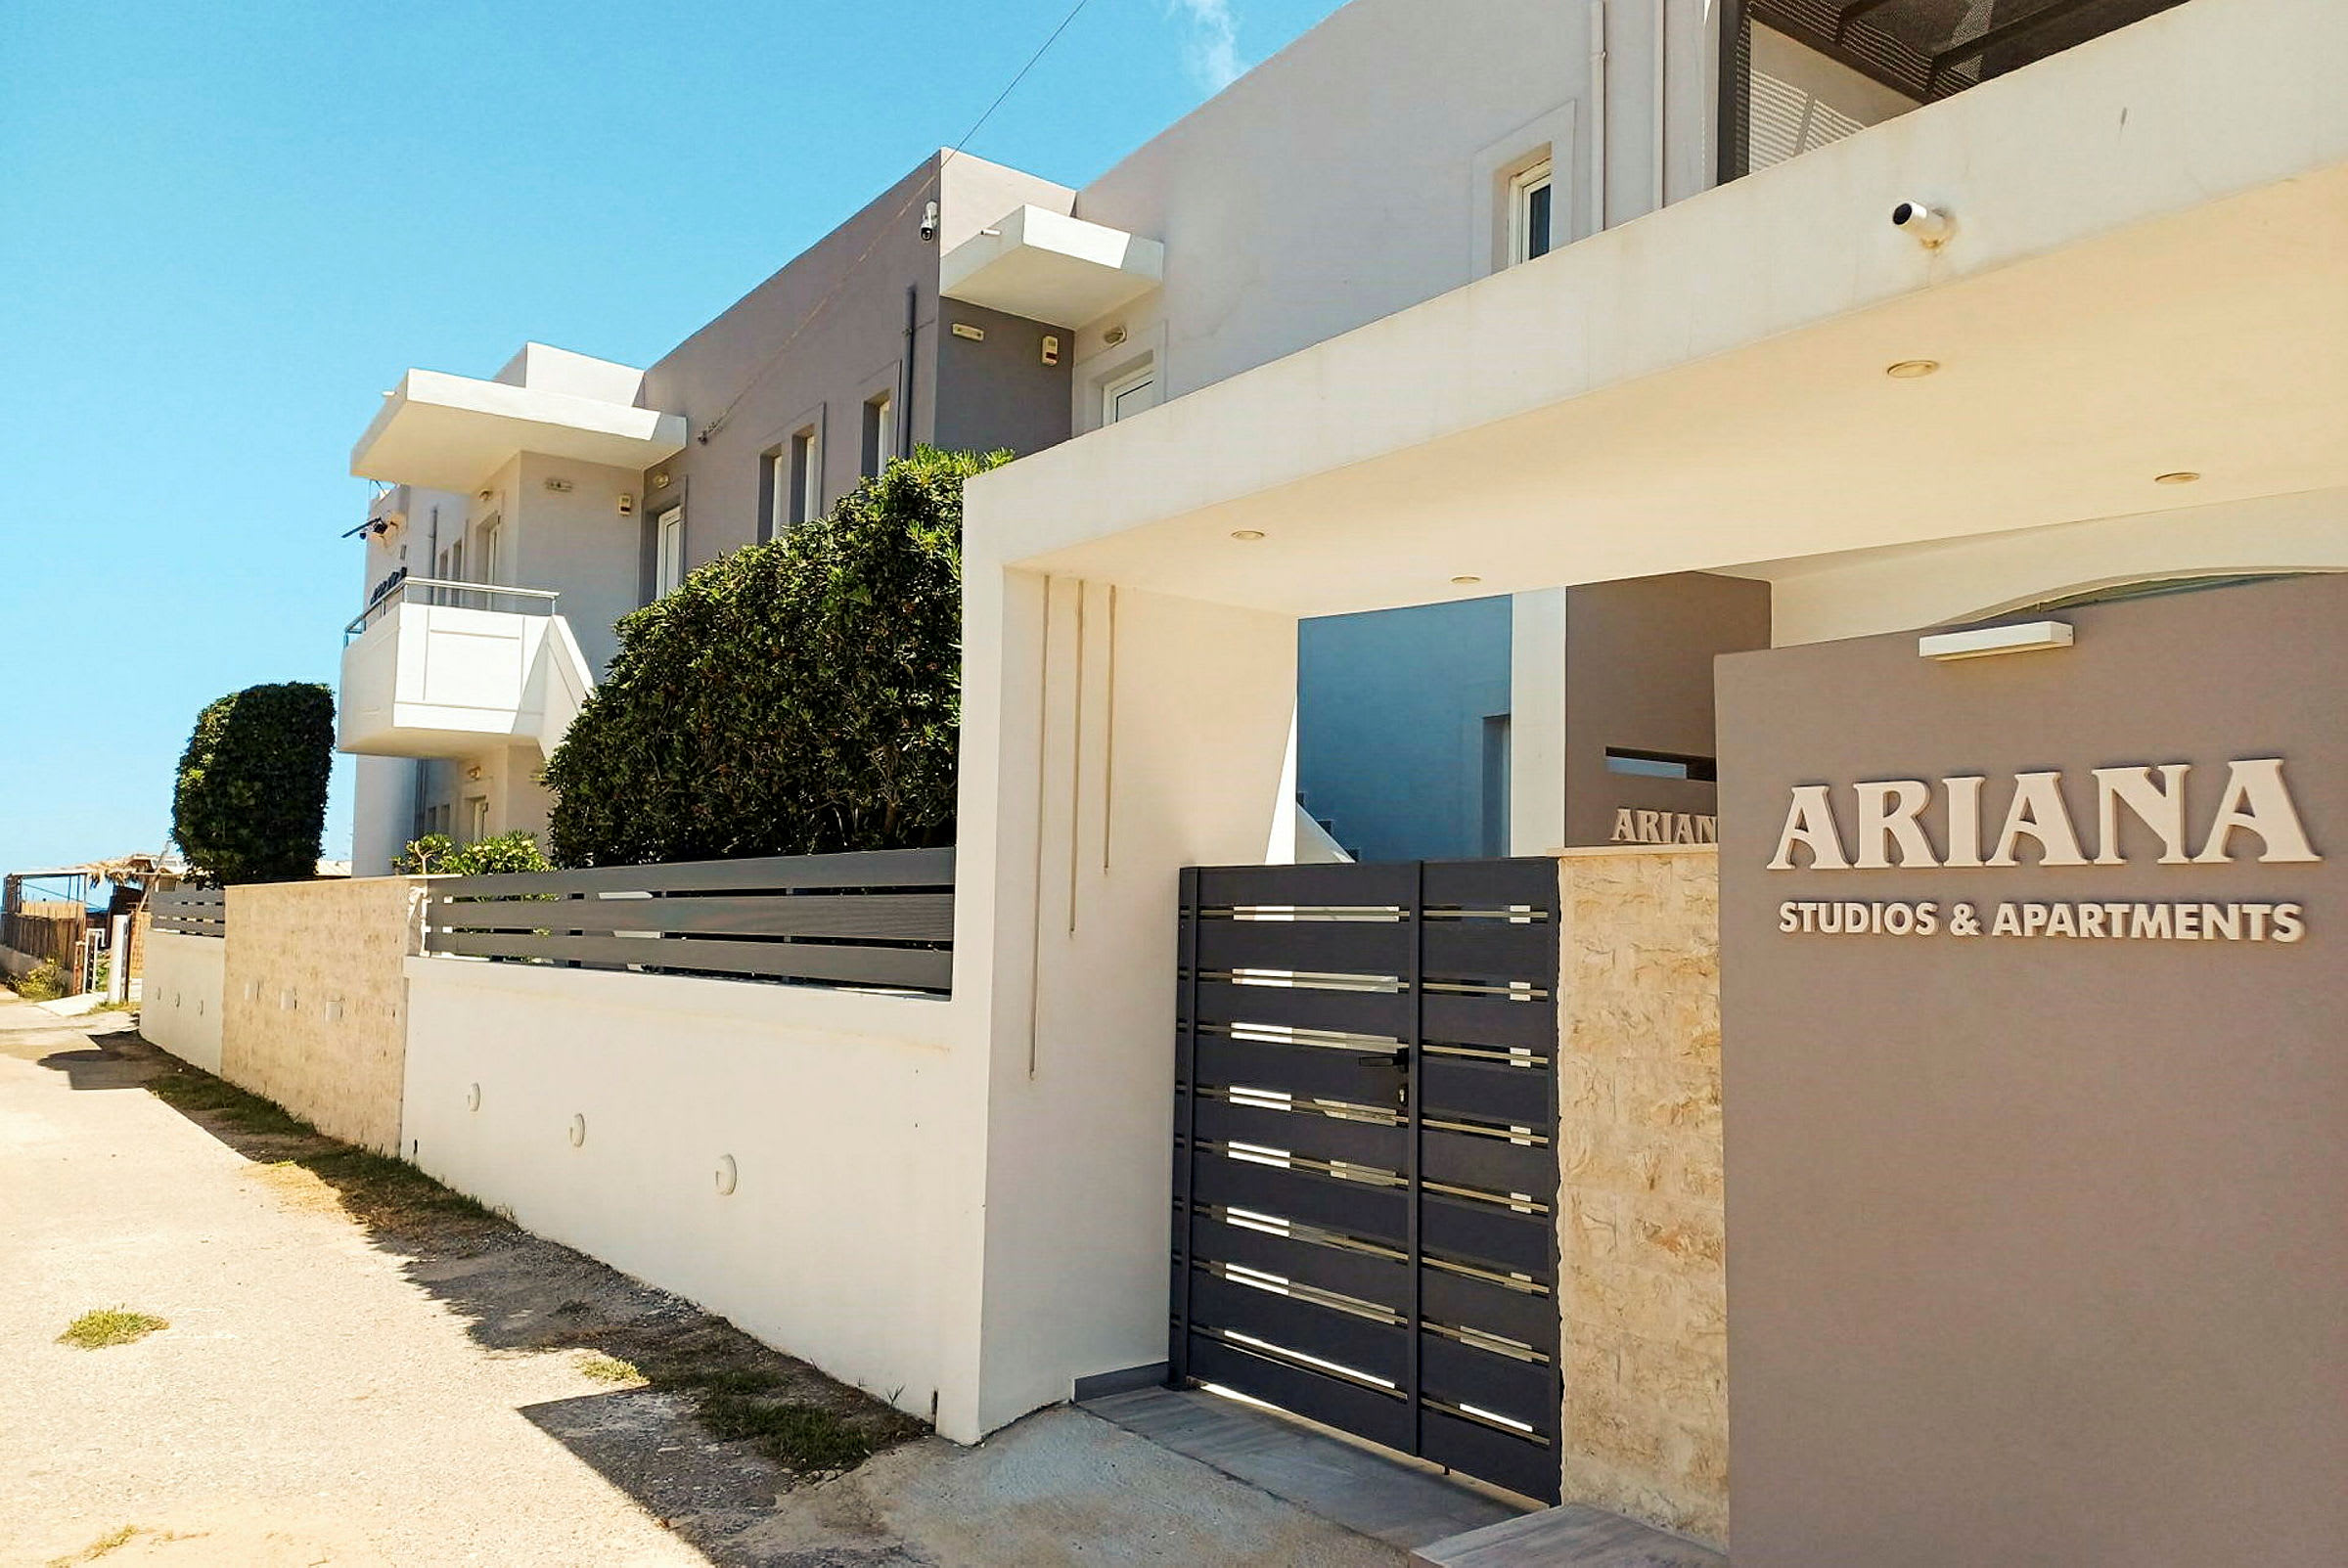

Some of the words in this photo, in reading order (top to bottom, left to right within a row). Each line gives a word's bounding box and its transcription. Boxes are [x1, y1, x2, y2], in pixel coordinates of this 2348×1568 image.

[1766, 757, 2323, 870] ARIANA
[1779, 901, 1938, 934] STUDIOS
[1950, 902, 1979, 936] &
[1991, 903, 2304, 943] APARTMENTS
